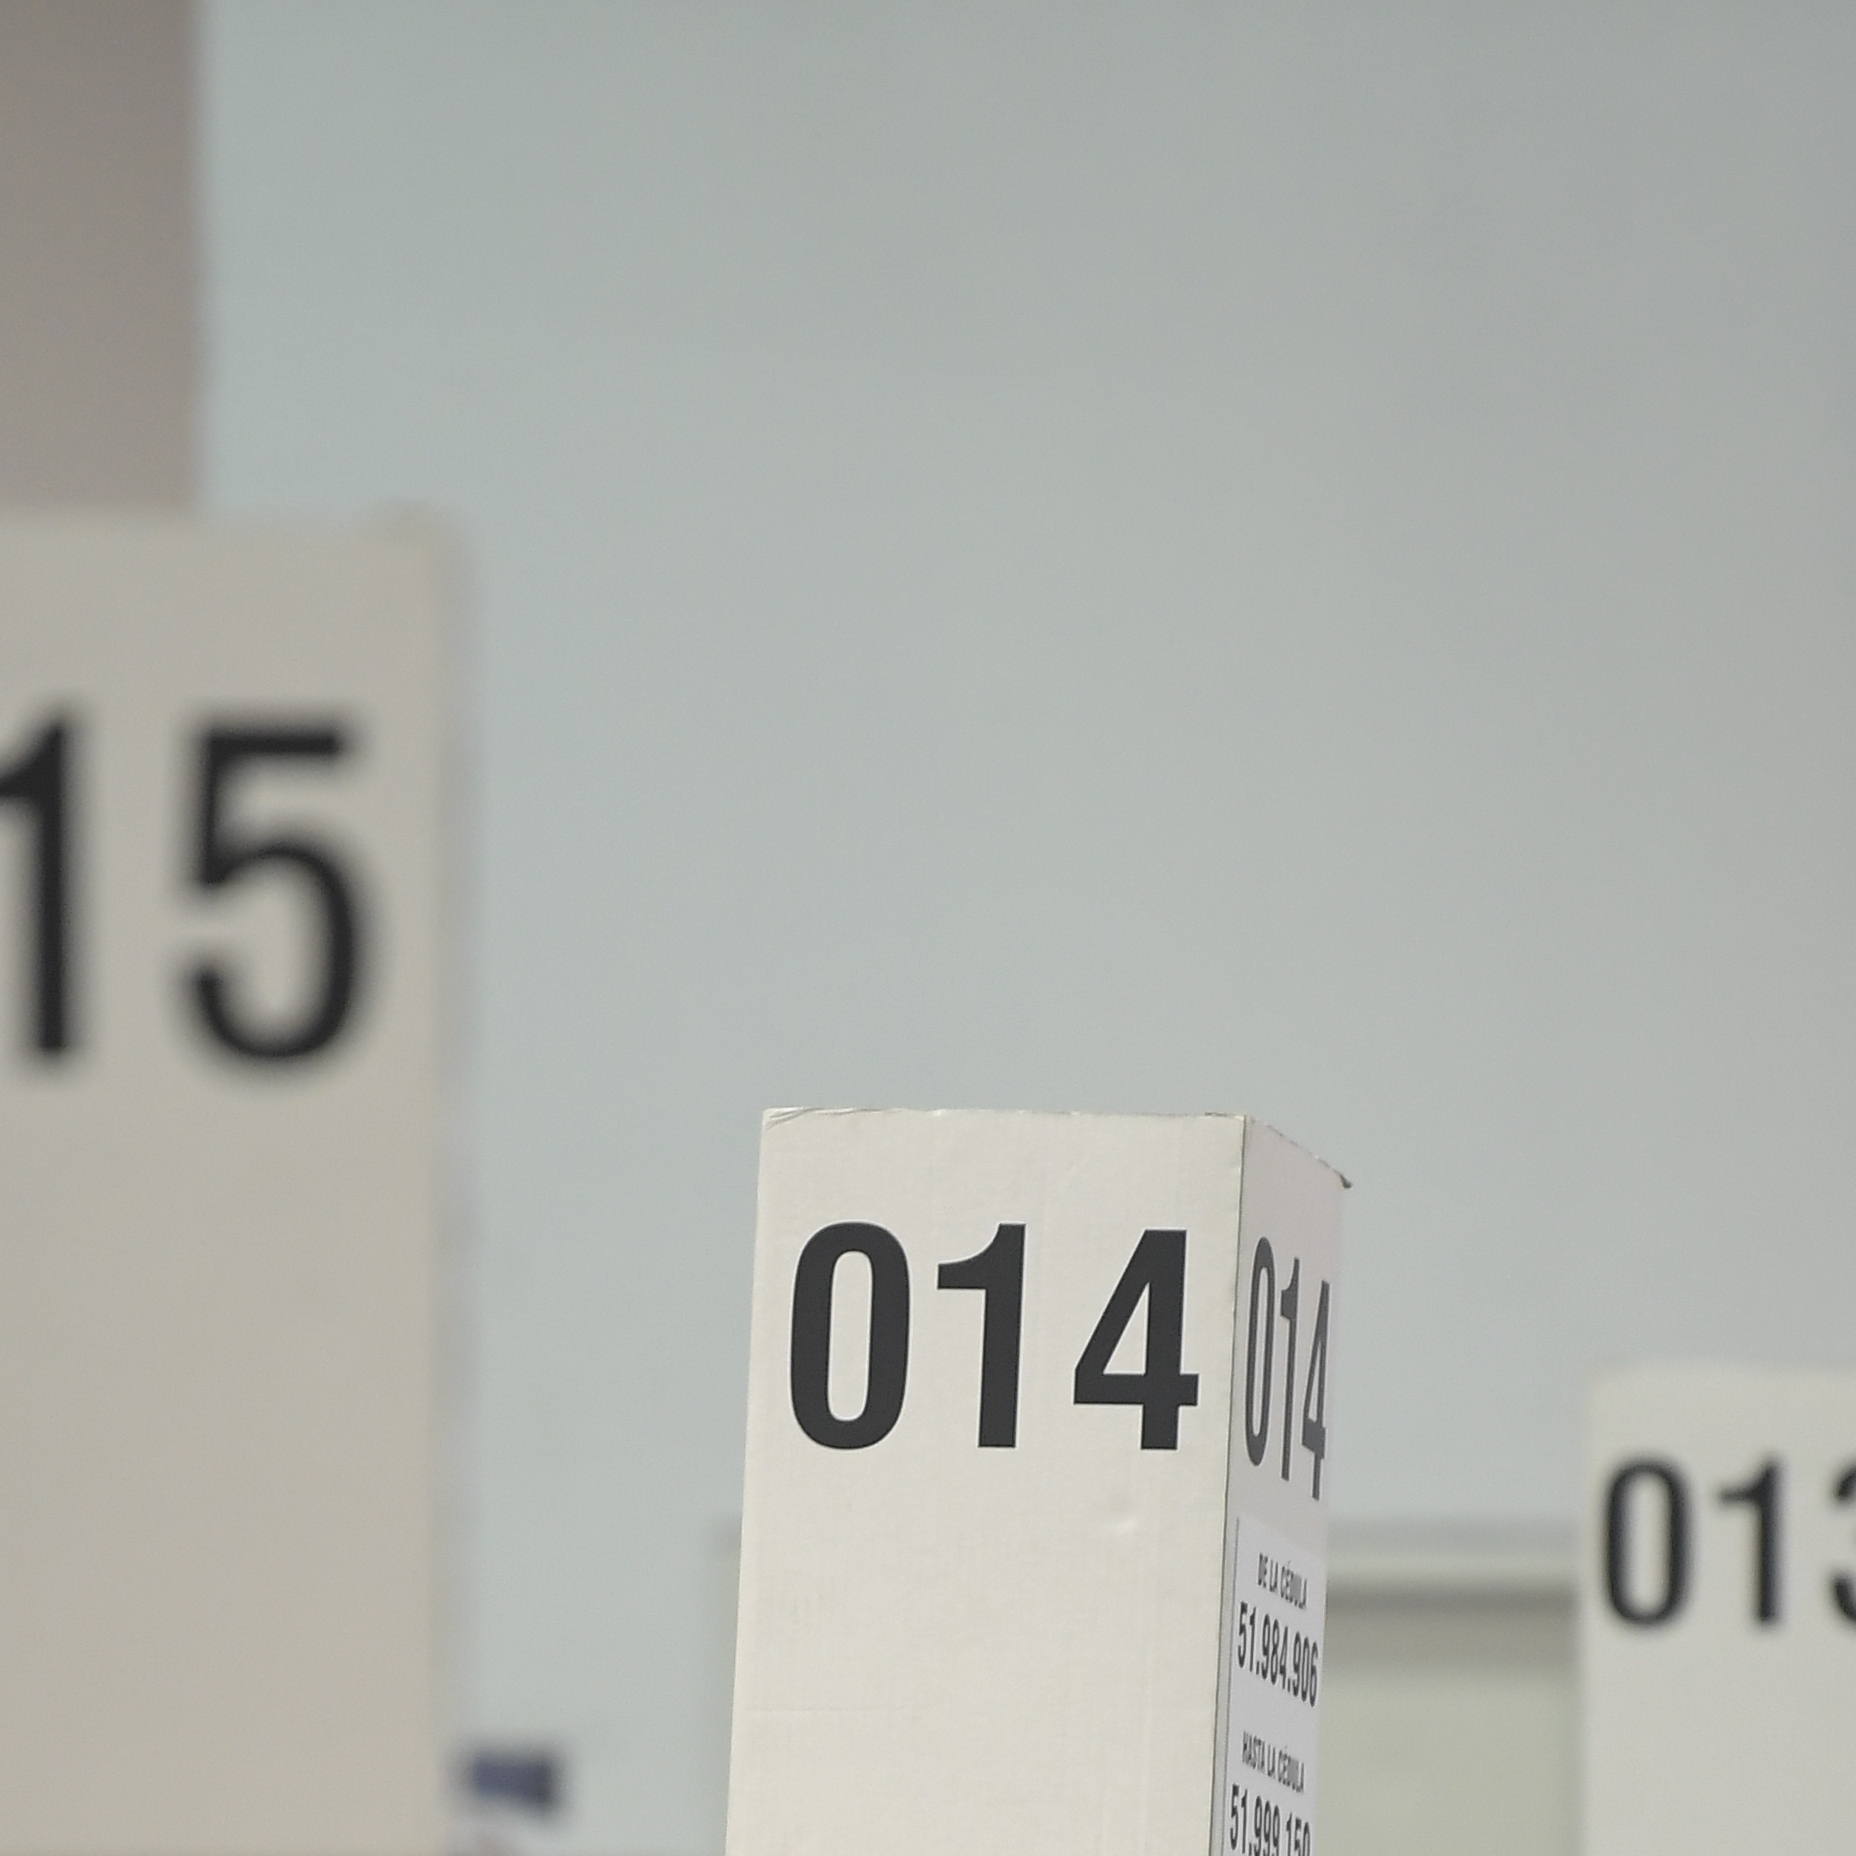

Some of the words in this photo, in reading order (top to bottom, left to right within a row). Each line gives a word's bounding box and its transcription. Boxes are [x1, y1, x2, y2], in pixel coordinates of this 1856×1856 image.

[790, 1222, 1200, 1451] 014
[1244, 1236, 1330, 1501] 014
[1237, 1600, 1319, 1708] 51.984.906
